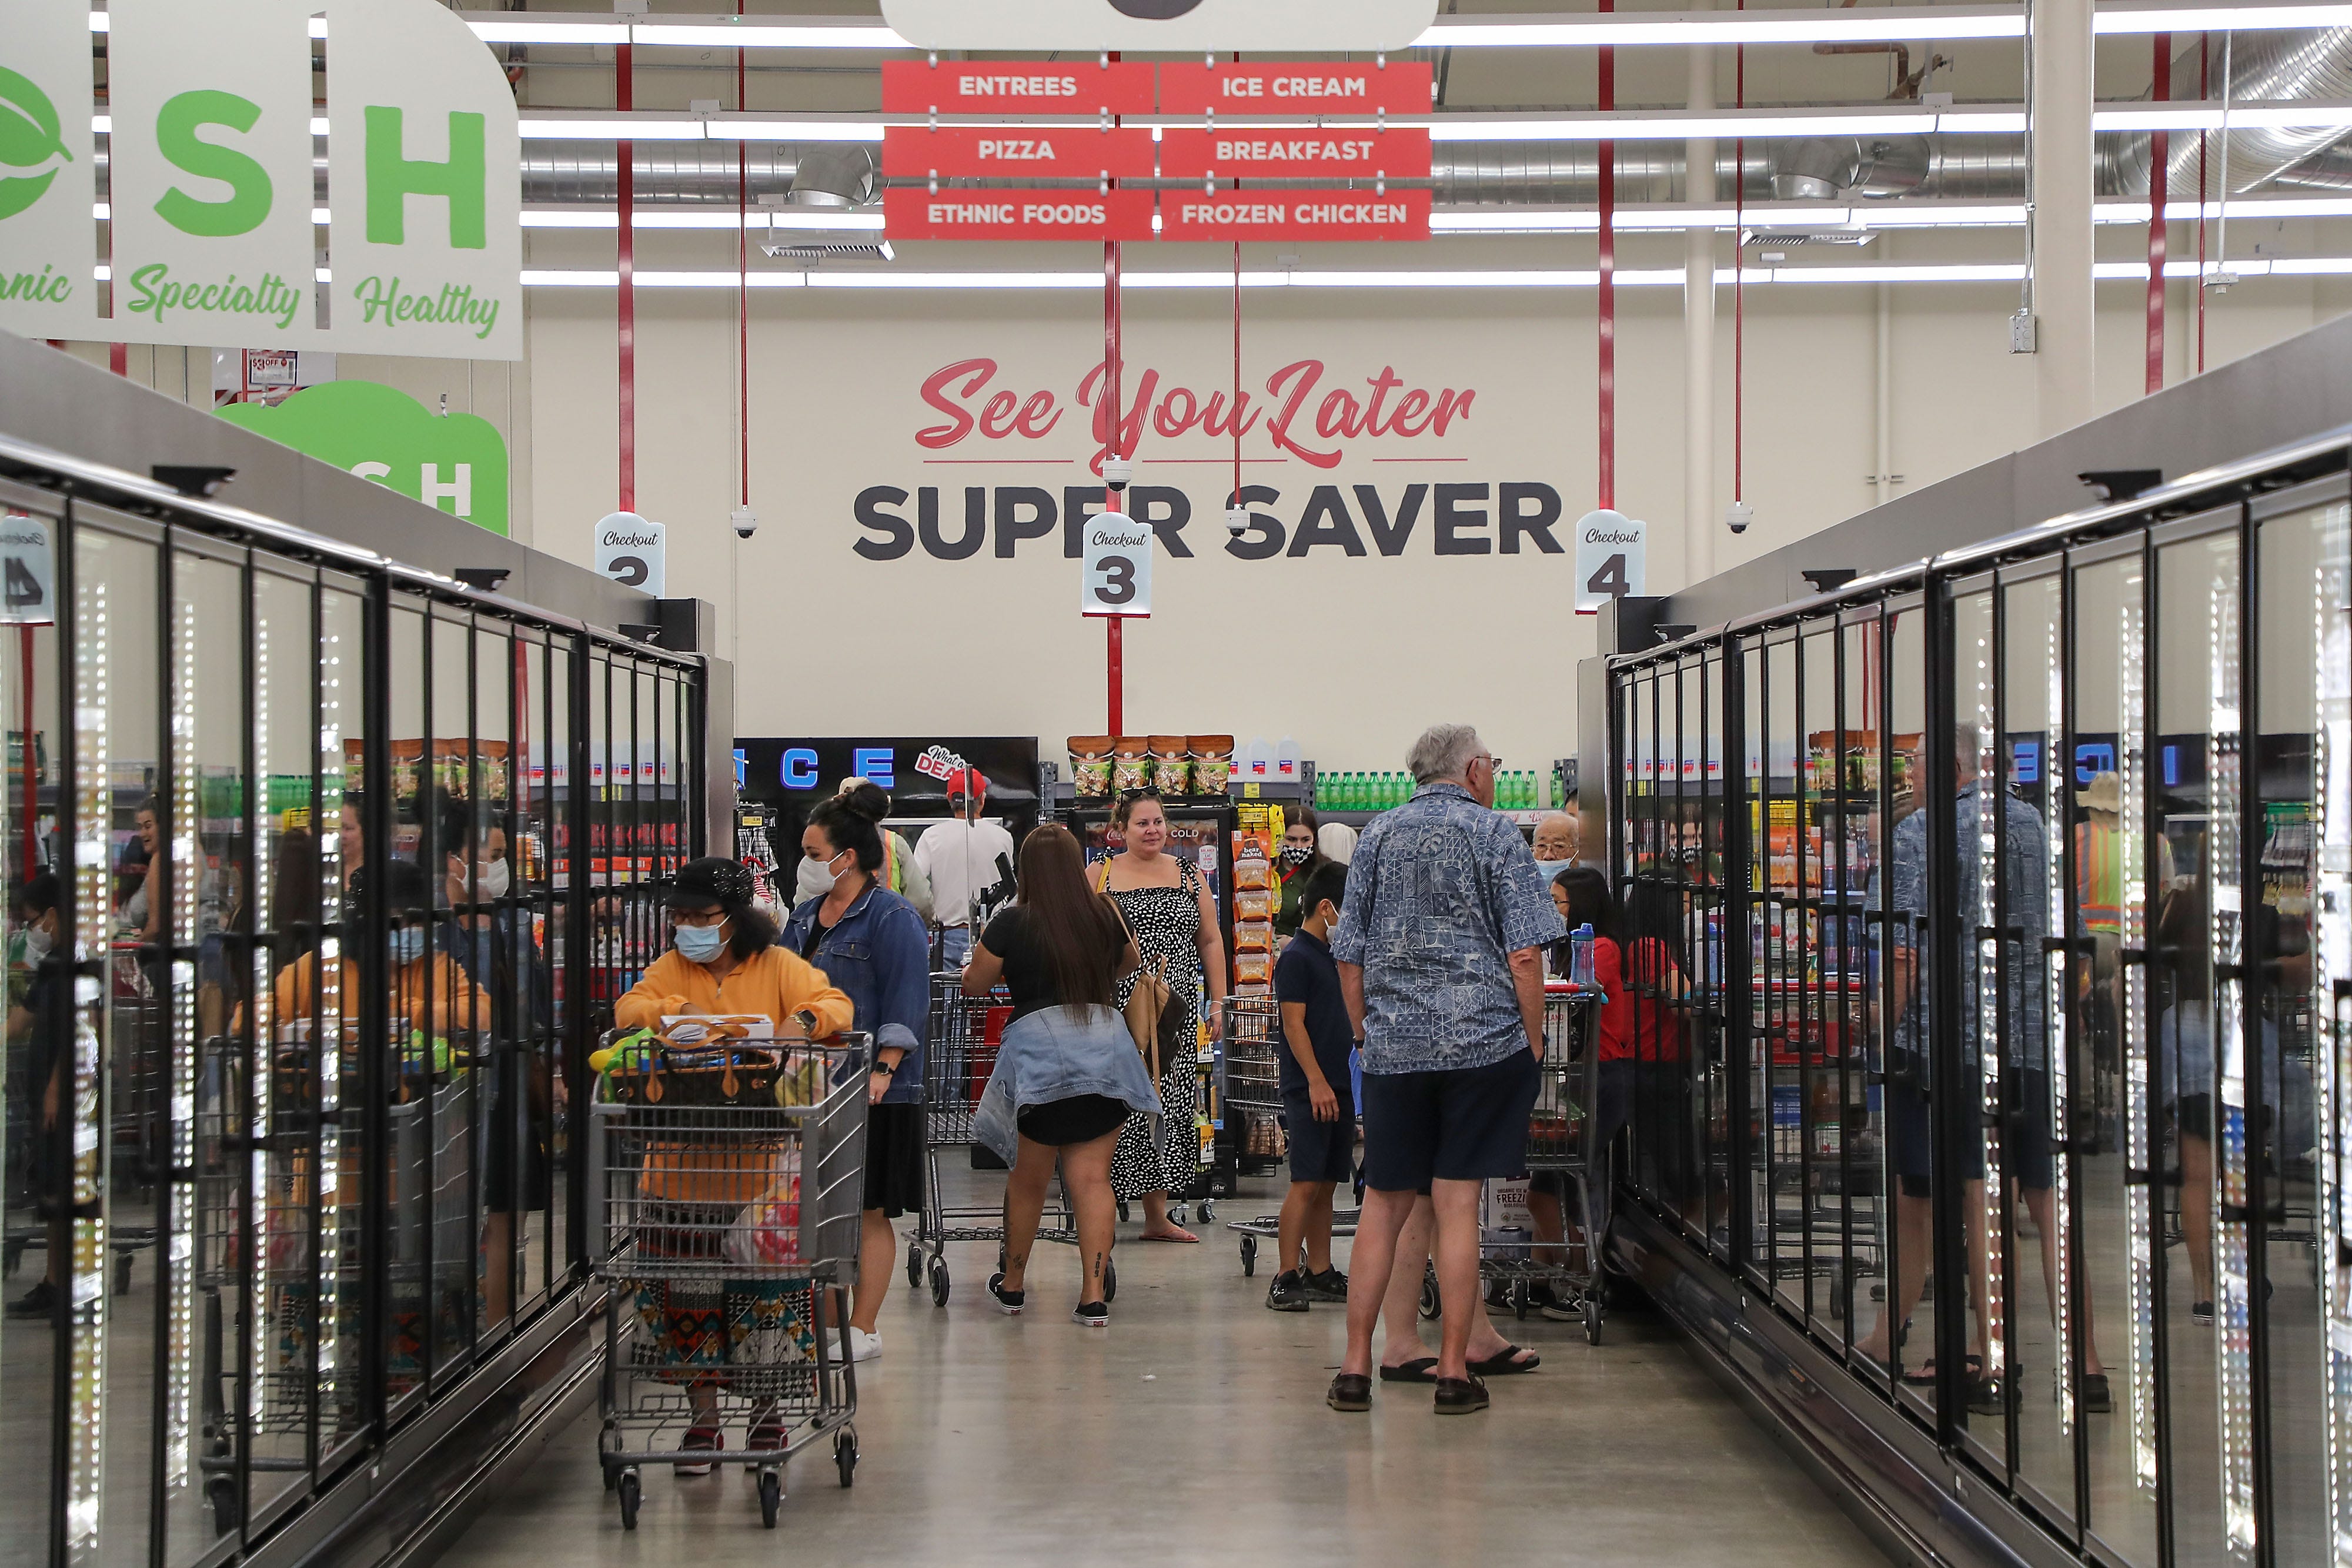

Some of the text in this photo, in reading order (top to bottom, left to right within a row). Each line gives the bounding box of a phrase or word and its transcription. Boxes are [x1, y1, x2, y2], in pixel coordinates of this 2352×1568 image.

[959, 76, 1077, 97] ENTREES
[1222, 77, 1365, 97] ICE CREAM
[978, 140, 1055, 160] PIZZA
[1216, 141, 1375, 161] BREAKFAST
[928, 203, 1106, 225] ETHNIC FOODS
[1182, 204, 1407, 224] FROZEN CHICKEN
[127, 263, 300, 330] Specialty
[354, 276, 500, 340] Healthy
[914, 358, 1476, 477] See You Later
[851, 482, 1566, 561] SUPER SAVER
[603, 531, 659, 547] Checkout
[1091, 530, 1147, 548] Checkout
[1585, 528, 1639, 545] Checkout
[1094, 556, 1136, 604] 3
[1587, 554, 1630, 598] 4
[930, 747, 958, 765] What
[918, 755, 957, 778] DEA
[1171, 830, 1199, 838] COLD
